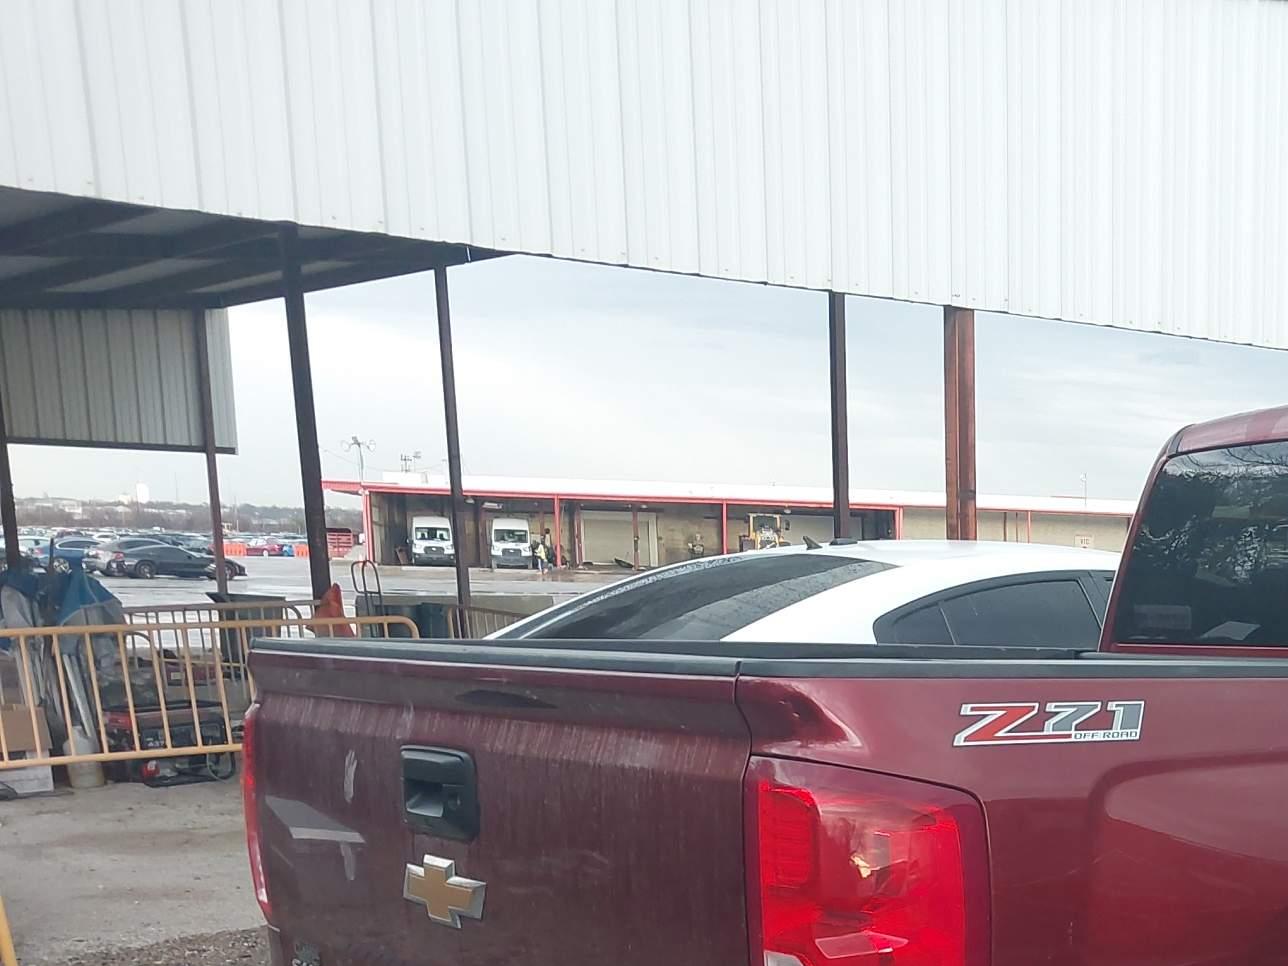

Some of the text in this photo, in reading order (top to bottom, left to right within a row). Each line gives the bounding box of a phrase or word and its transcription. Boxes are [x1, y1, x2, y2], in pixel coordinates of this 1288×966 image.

[953, 700, 1145, 747] Z71
[1073, 730, 1138, 741] OFF ROAD
